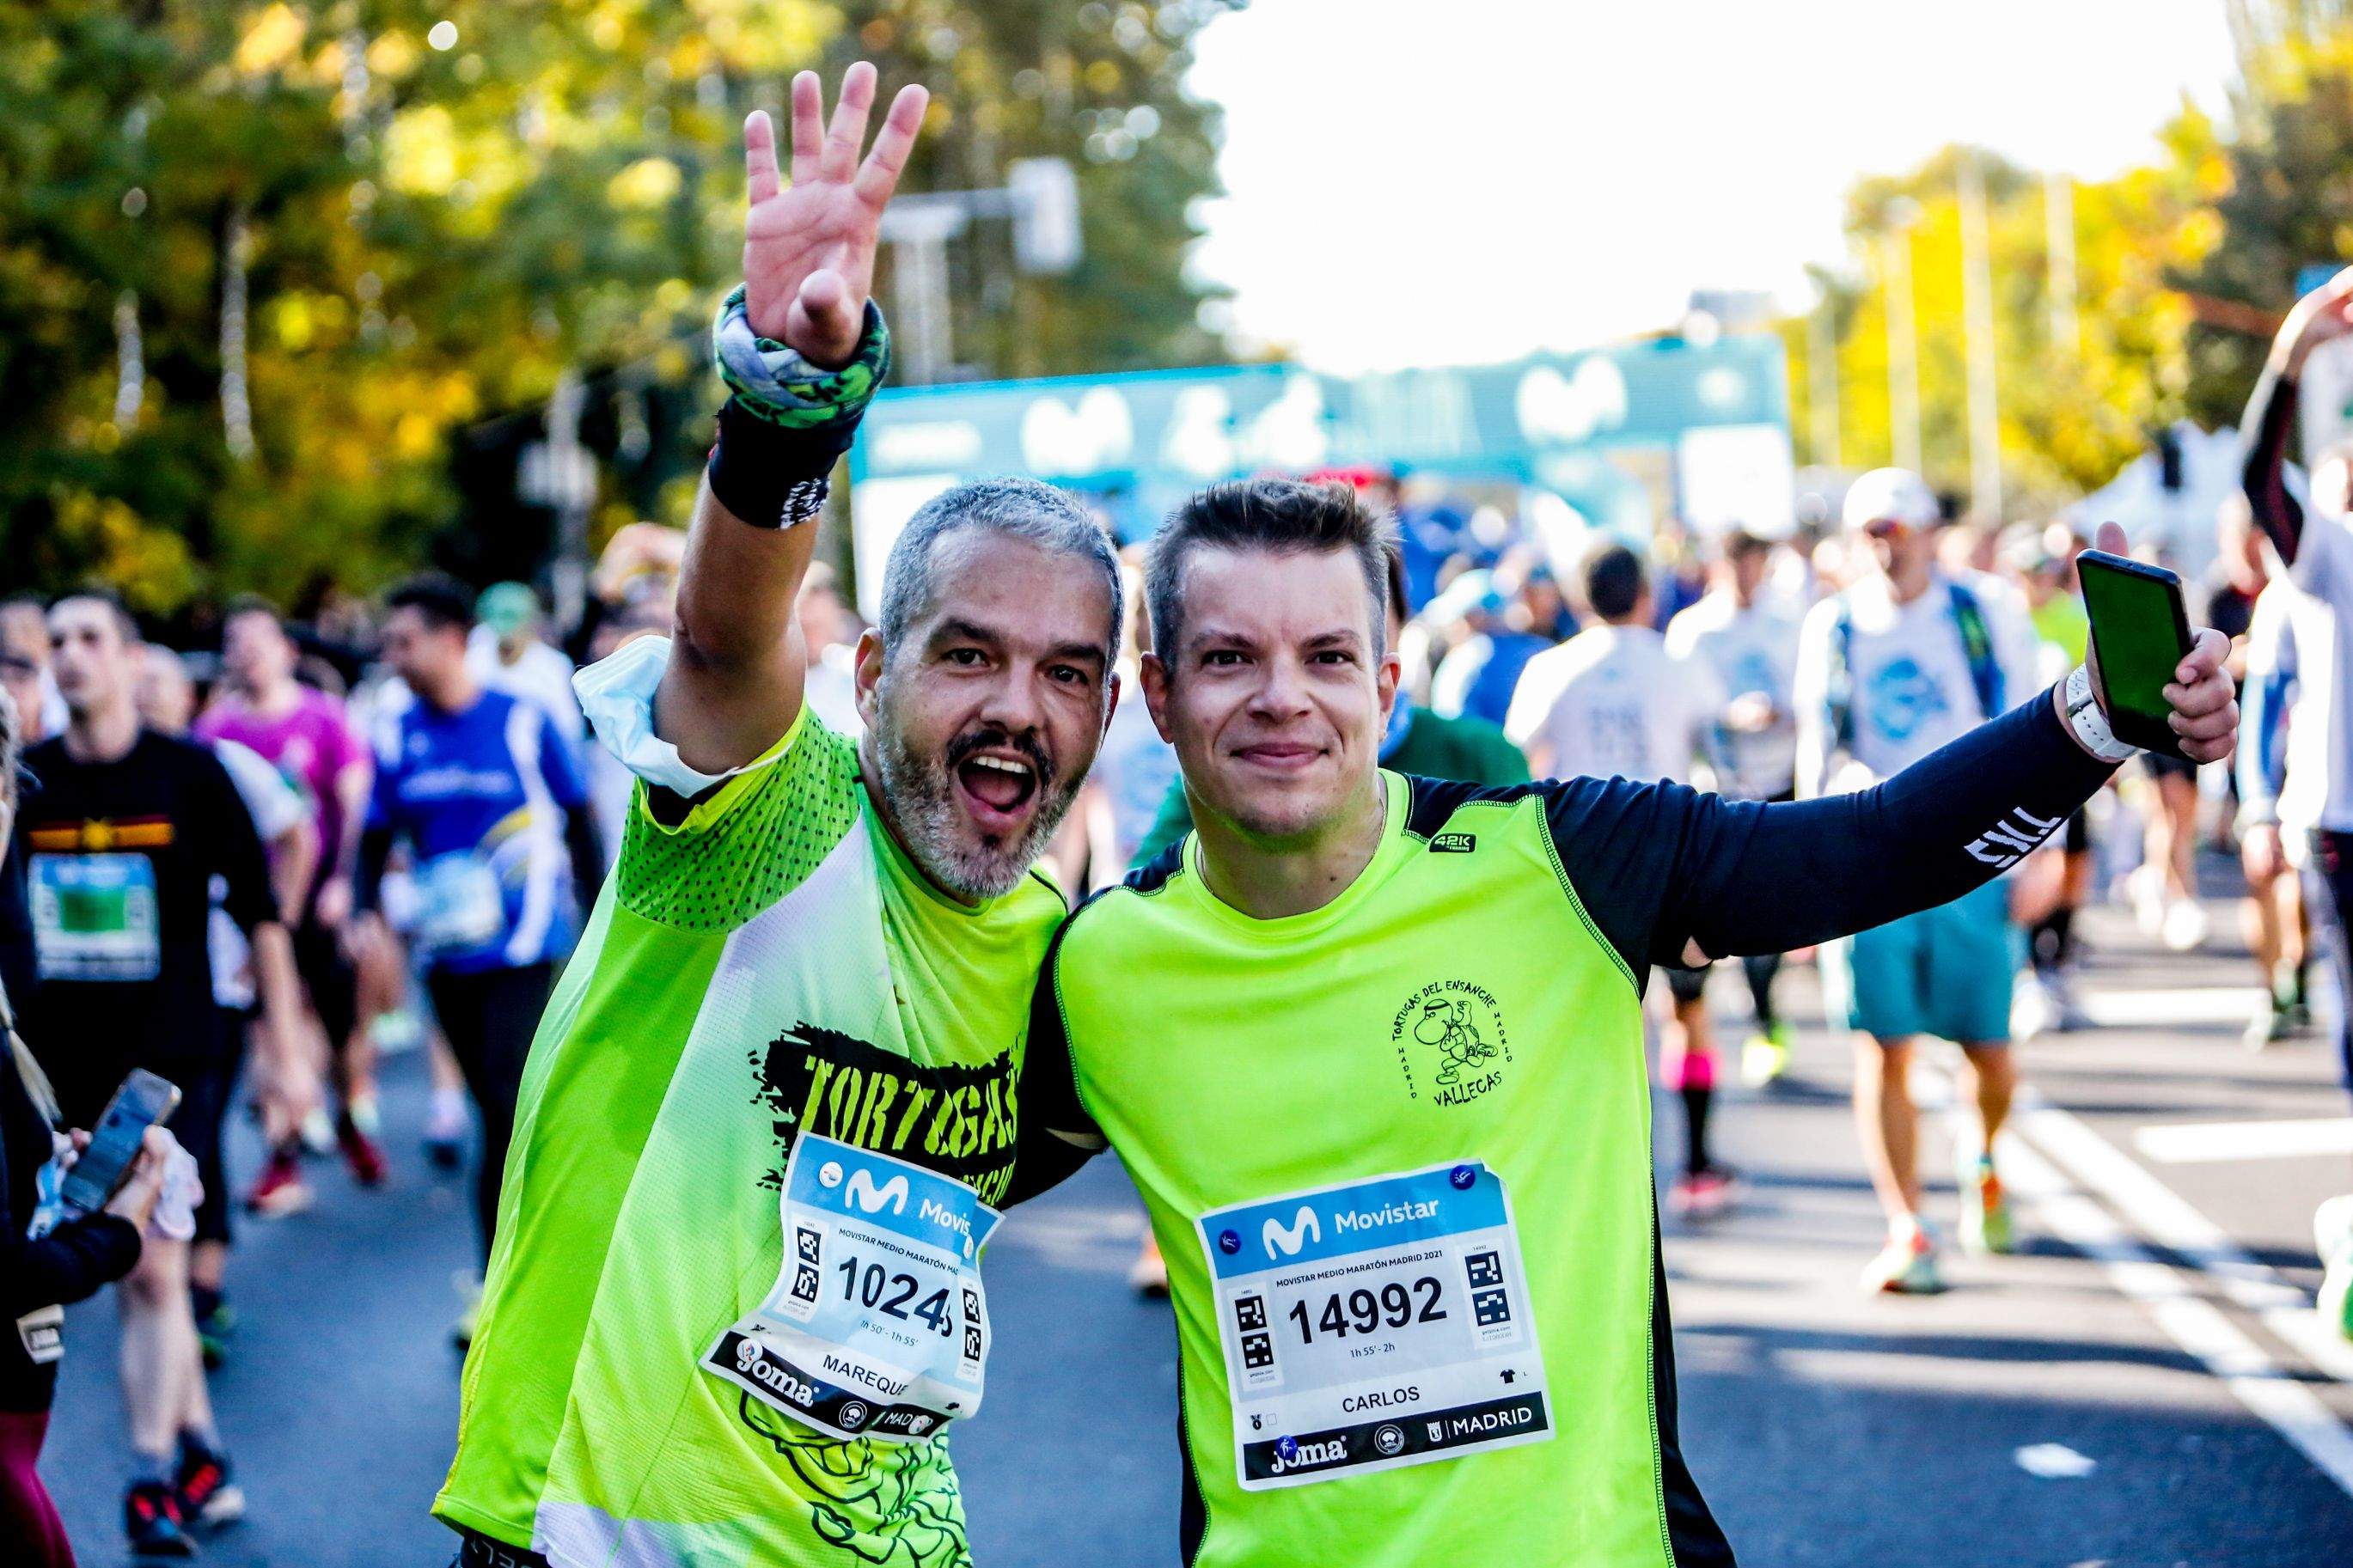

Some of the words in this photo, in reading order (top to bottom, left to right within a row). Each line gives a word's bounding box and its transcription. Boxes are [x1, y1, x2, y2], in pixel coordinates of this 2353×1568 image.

[1434, 835, 1470, 846] 42K
[1392, 993, 1421, 1041] TORTUGAS
[1422, 982, 1442, 998] DEL
[1445, 979, 1497, 1009] ENSANCHE
[1433, 1071, 1502, 1107] VALLECAS
[920, 1199, 971, 1236] Movis
[1335, 1199, 1439, 1234] Movistar
[839, 1228, 876, 1245] MOVISTAR
[877, 1240, 905, 1255] MEDIO
[906, 1251, 946, 1270] MARATÓN
[1276, 1274, 1316, 1287] MOVISTAR
[1317, 1268, 1345, 1280] MEDIO
[1346, 1260, 1388, 1274] MARATÓN
[1389, 1254, 1423, 1266] MADRID
[1424, 1250, 1443, 1260] 2021
[1289, 1277, 1447, 1345] 14992
[860, 1320, 869, 1329] 1h
[891, 1332, 901, 1342] 1h
[1350, 1349, 1361, 1358] 1h
[1384, 1342, 1396, 1352] 2h
[1342, 1386, 1420, 1412] CARLOS
[884, 1412, 914, 1426] MAD
[1452, 1406, 1532, 1437] MADRID
